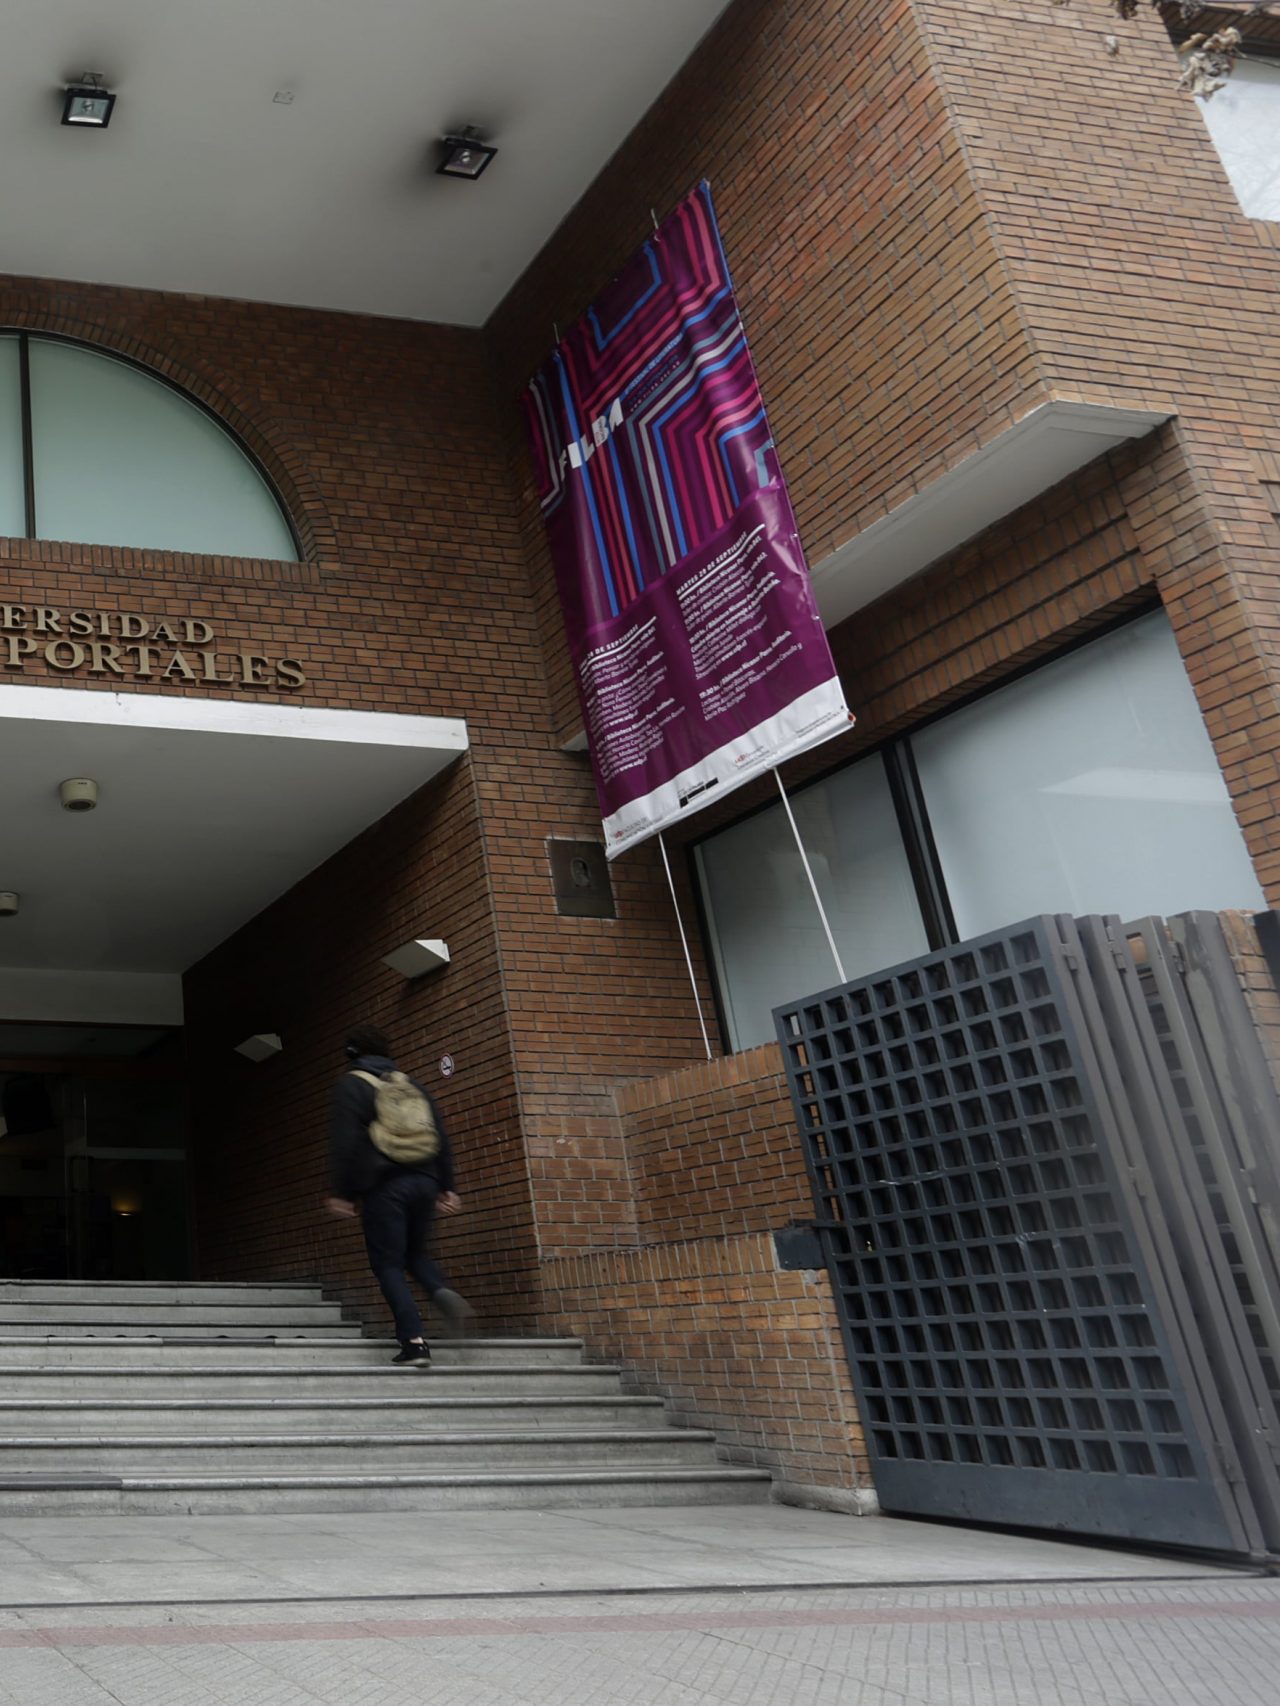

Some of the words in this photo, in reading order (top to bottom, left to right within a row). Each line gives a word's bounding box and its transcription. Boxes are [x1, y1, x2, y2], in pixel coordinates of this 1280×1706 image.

[558, 397, 624, 482] FILBA
[676, 574, 699, 595] MARTES
[715, 531, 747, 564] SEPTIEMBRE
[3, 635, 308, 689] PORTALES
